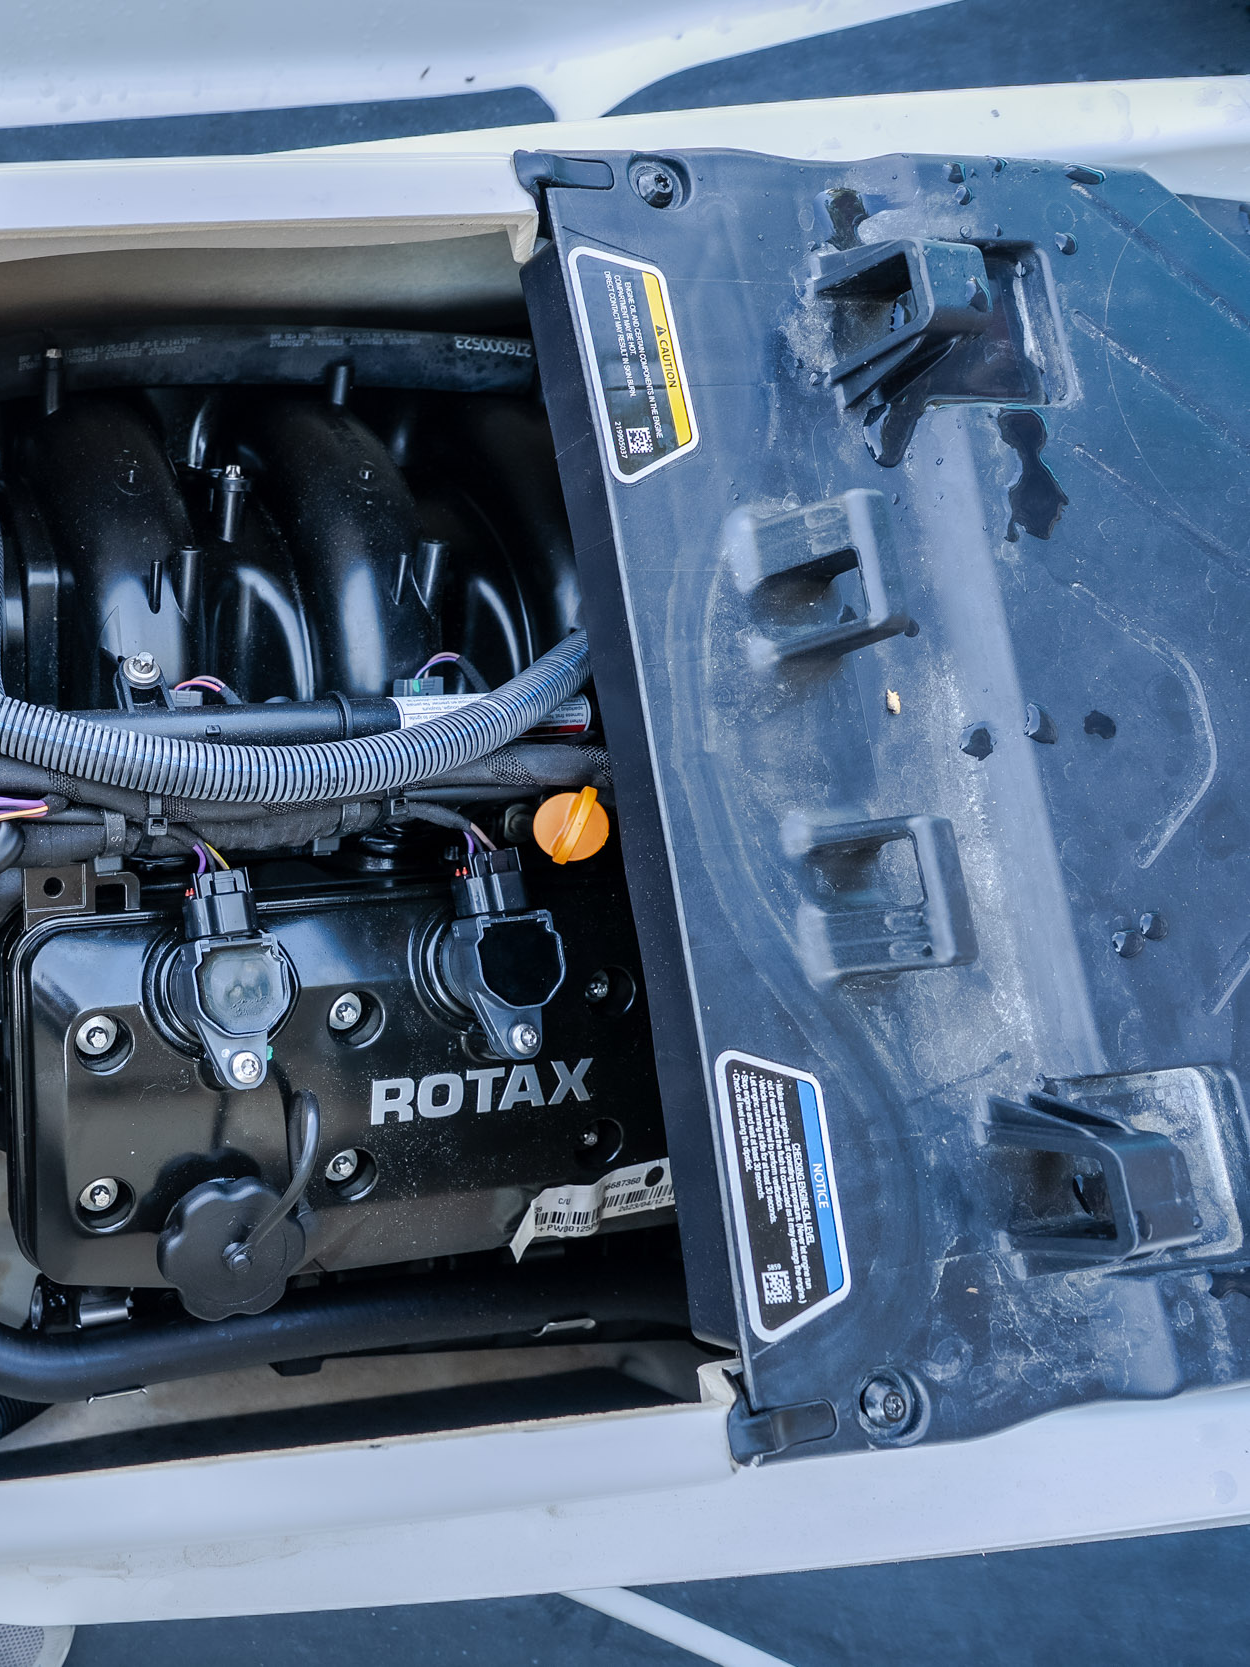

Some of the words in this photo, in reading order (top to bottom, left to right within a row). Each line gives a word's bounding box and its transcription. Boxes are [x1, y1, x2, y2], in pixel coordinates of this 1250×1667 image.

[603, 270, 614, 292] DIRECT
[613, 274, 628, 319] COMPARTMENT
[623, 281, 634, 304] ENGINE
[608, 292, 620, 320] CONTACT
[628, 304, 637, 315] OIL
[614, 320, 623, 334] MAY
[622, 319, 631, 333] MAY
[630, 314, 639, 327] AND
[625, 331, 633, 341] BE
[633, 327, 645, 353] CERTAIN
[452, 335, 532, 357] 276000523
[617, 333, 628, 357] RESULT
[627, 341, 636, 355] HOT.
[621, 356, 629, 364] IN
[658, 338, 677, 389] CAUTION
[623, 364, 632, 379] SKIN
[638, 353, 654, 395] COMPONENTS
[626, 378, 636, 397] BURN.
[647, 395, 655, 403] IN
[649, 402, 658, 415] THE
[651, 415, 663, 439] ENGINE
[613, 420, 628, 459] 219905037
[731, 1072, 741, 1093] Check
[739, 1074, 749, 1089] Stop
[749, 1075, 757, 1086] Let
[765, 1079, 773, 1090] out
[370, 1058, 594, 1125] ROTAX
[735, 1093, 743, 1102] oil
[749, 1086, 760, 1108] engine
[757, 1078, 767, 1101] Vehicle
[767, 1090, 775, 1098] of
[774, 1083, 784, 1101] Make
[741, 1089, 752, 1112] engine
[768, 1098, 777, 1116] water
[777, 1101, 786, 1115] sure
[736, 1101, 745, 1117] level
[761, 1101, 769, 1118] must
[745, 1111, 754, 1124] and
[752, 1108, 763, 1132] running
[763, 1118, 771, 1127] be
[736, 1117, 747, 1135] using
[747, 1124, 756, 1138] wait
[771, 1116, 781, 1138] without
[778, 1116, 789, 1138] engine
[741, 1135, 749, 1146] the
[749, 1138, 757, 1146] at
[757, 1132, 764, 1140] at
[764, 1127, 773, 1143] level
[758, 1139, 767, 1152] idle
[775, 1138, 783, 1150] the
[783, 1144, 791, 1152] at
[741, 1146, 753, 1172] dipstick.
[750, 1145, 760, 1162] least
[760, 1152, 768, 1162] for
[776, 1149, 785, 1165] flush
[791, 1142, 805, 1181] CHECKING
[752, 1161, 761, 1171] 30
[761, 1161, 769, 1169] at
[767, 1150, 778, 1175] perform
[783, 1152, 796, 1182] operating
[753, 1170, 765, 1200] seconds.
[762, 1169, 772, 1185] least
[764, 1185, 772, 1195] 30
[771, 1175, 784, 1211] verification.
[779, 1173, 792, 1208] connected
[811, 1162, 829, 1209] NOTICE
[557, 1196, 571, 1206] C/U
[788, 1181, 802, 1222] temperature.
[797, 1180, 809, 1209] ENGINE
[617, 1197, 664, 1212] 2023/04/12
[765, 1195, 776, 1224] seconds.
[785, 1208, 792, 1217] as
[801, 1209, 811, 1220] OIL
[785, 1222, 795, 1237] may
[795, 1222, 805, 1244] (Never
[803, 1221, 815, 1245] LEVEL
[787, 1237, 800, 1265] damage
[799, 1244, 807, 1255] let
[793, 1264, 802, 1276] the
[799, 1254, 810, 1277] engine
[794, 1276, 806, 1304] engine.)
[804, 1277, 812, 1289] run
